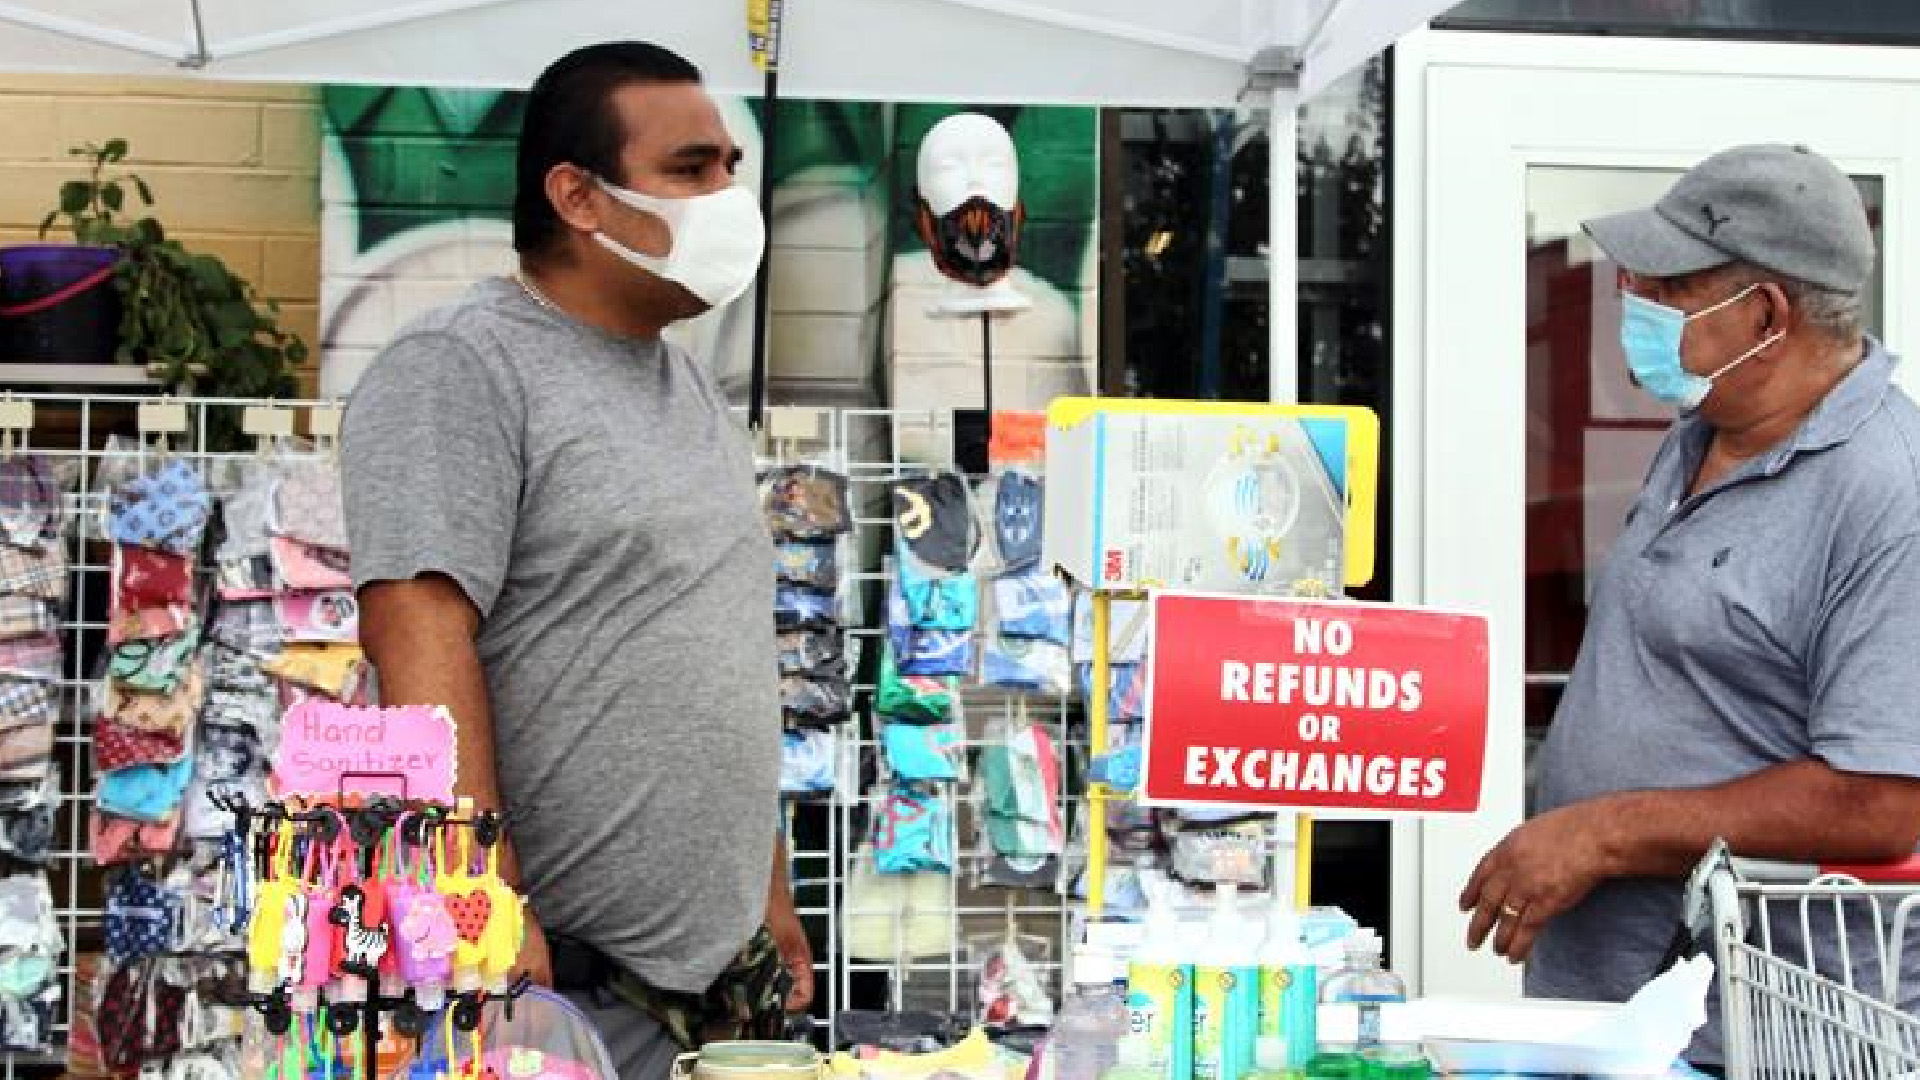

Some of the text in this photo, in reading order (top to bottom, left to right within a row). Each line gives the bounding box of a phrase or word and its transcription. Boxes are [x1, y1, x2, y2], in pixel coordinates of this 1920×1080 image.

[1104, 548, 1123, 582] 3M
[1294, 618, 1353, 655] NO
[1220, 659, 1423, 712] REFUNDS
[303, 711, 387, 743] Hand
[1298, 715, 1341, 742] OR
[291, 751, 439, 774] Sanitizer
[1184, 746, 1448, 797] EXCHANGES
